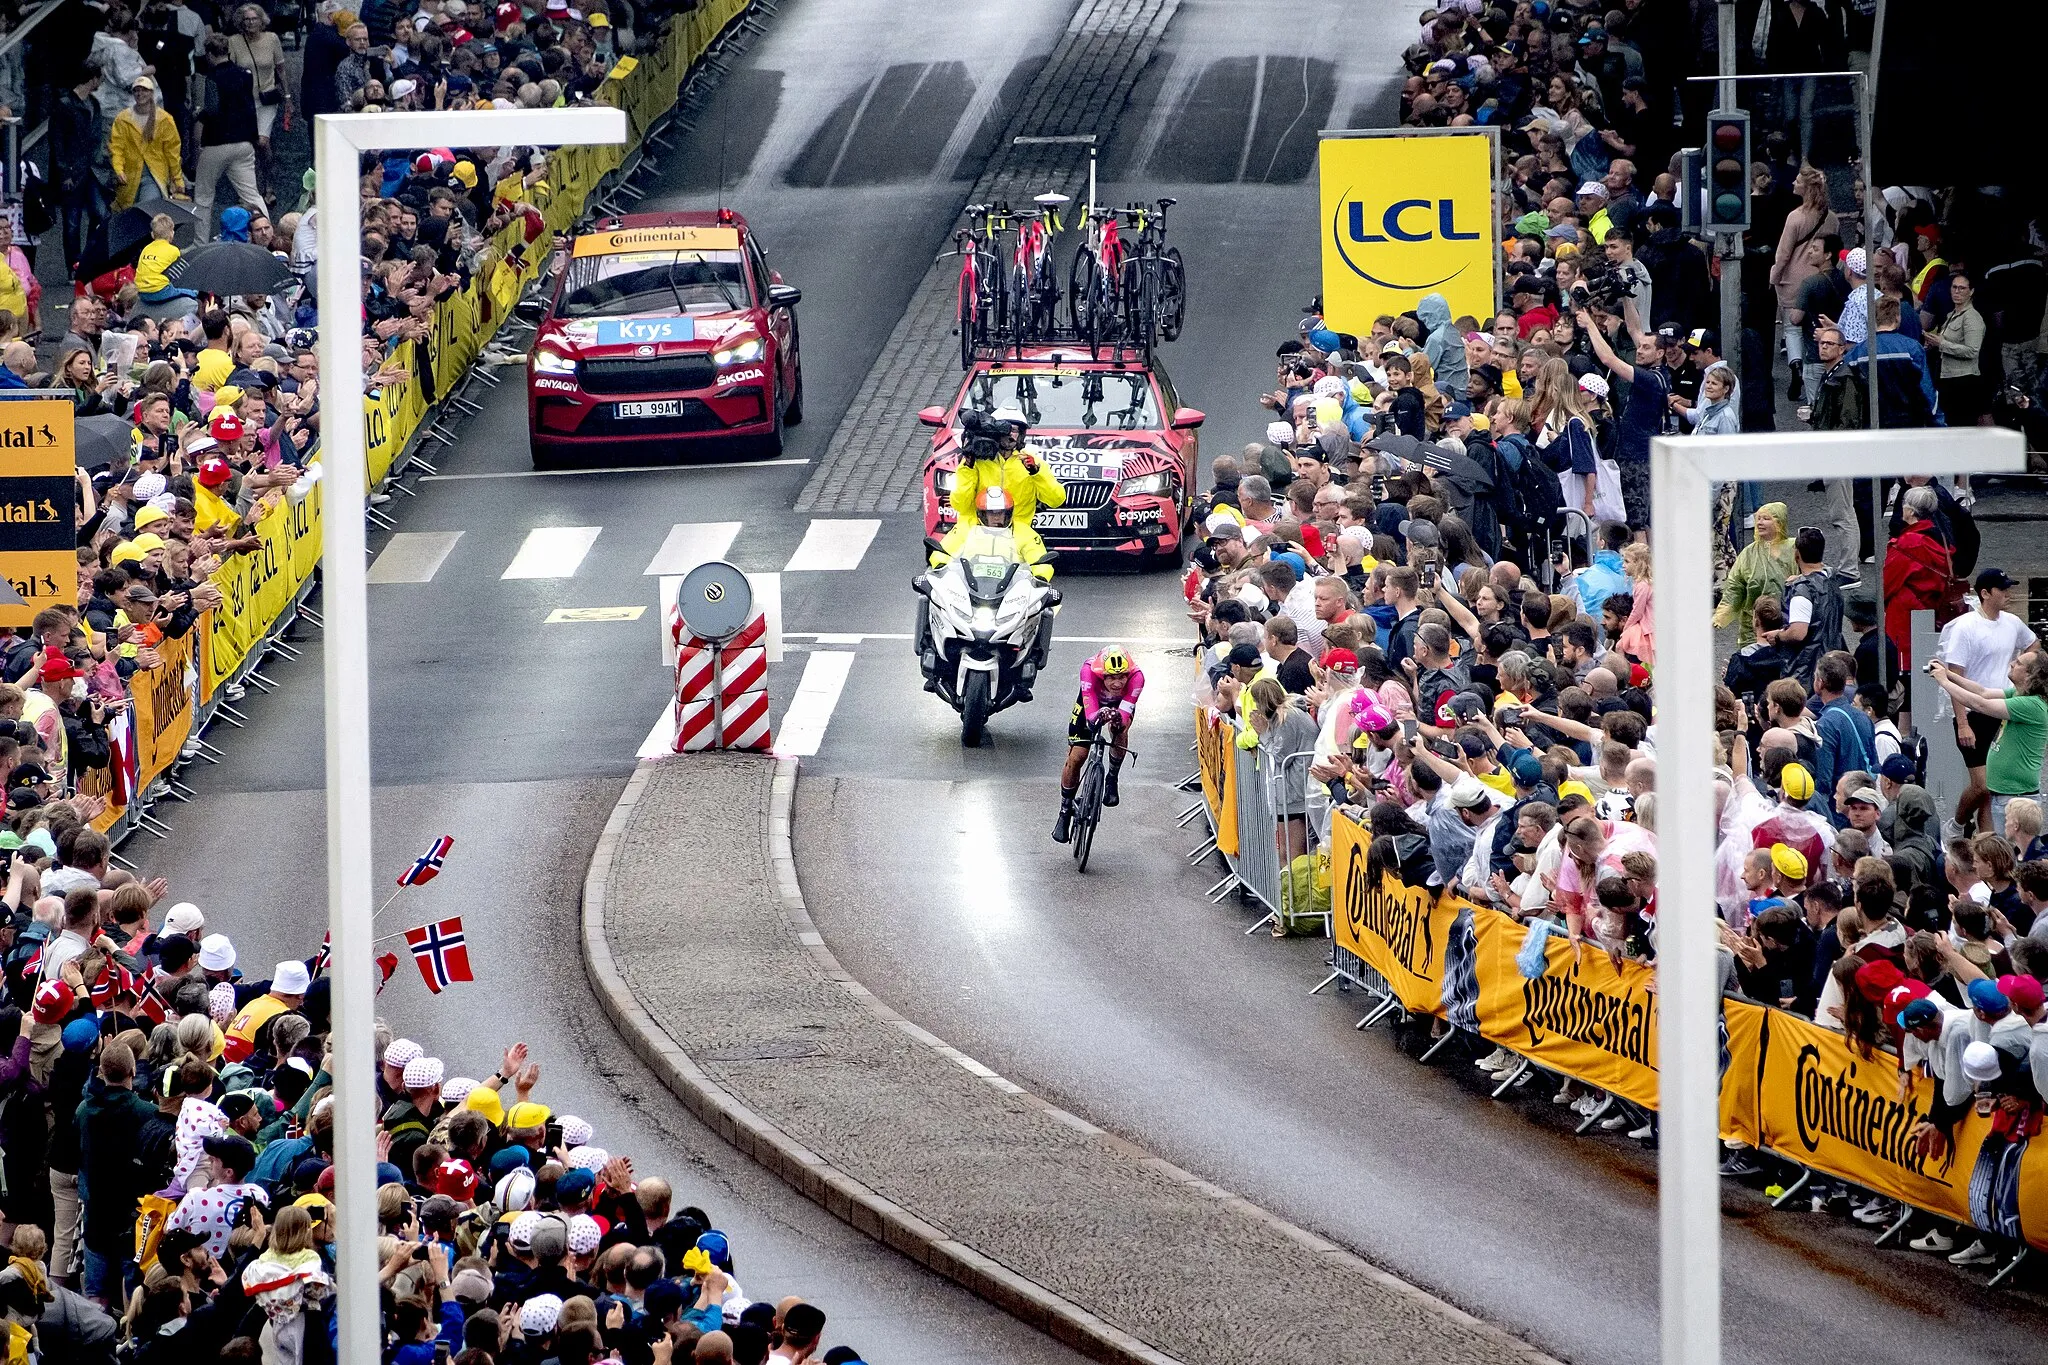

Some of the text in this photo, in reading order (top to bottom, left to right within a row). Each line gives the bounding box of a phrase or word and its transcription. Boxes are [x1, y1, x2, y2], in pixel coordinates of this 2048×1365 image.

[1348, 199, 1480, 242] LCL
[610, 231, 685, 247] Continental
[620, 322, 672, 342] Krys
[716, 368, 764, 387] ŠKODA
[622, 401, 678, 416] EL3 99AM
[1039, 451, 1103, 464] ISSOT
[1060, 513, 1084, 527] KVN
[986, 568, 1003, 578] 563
